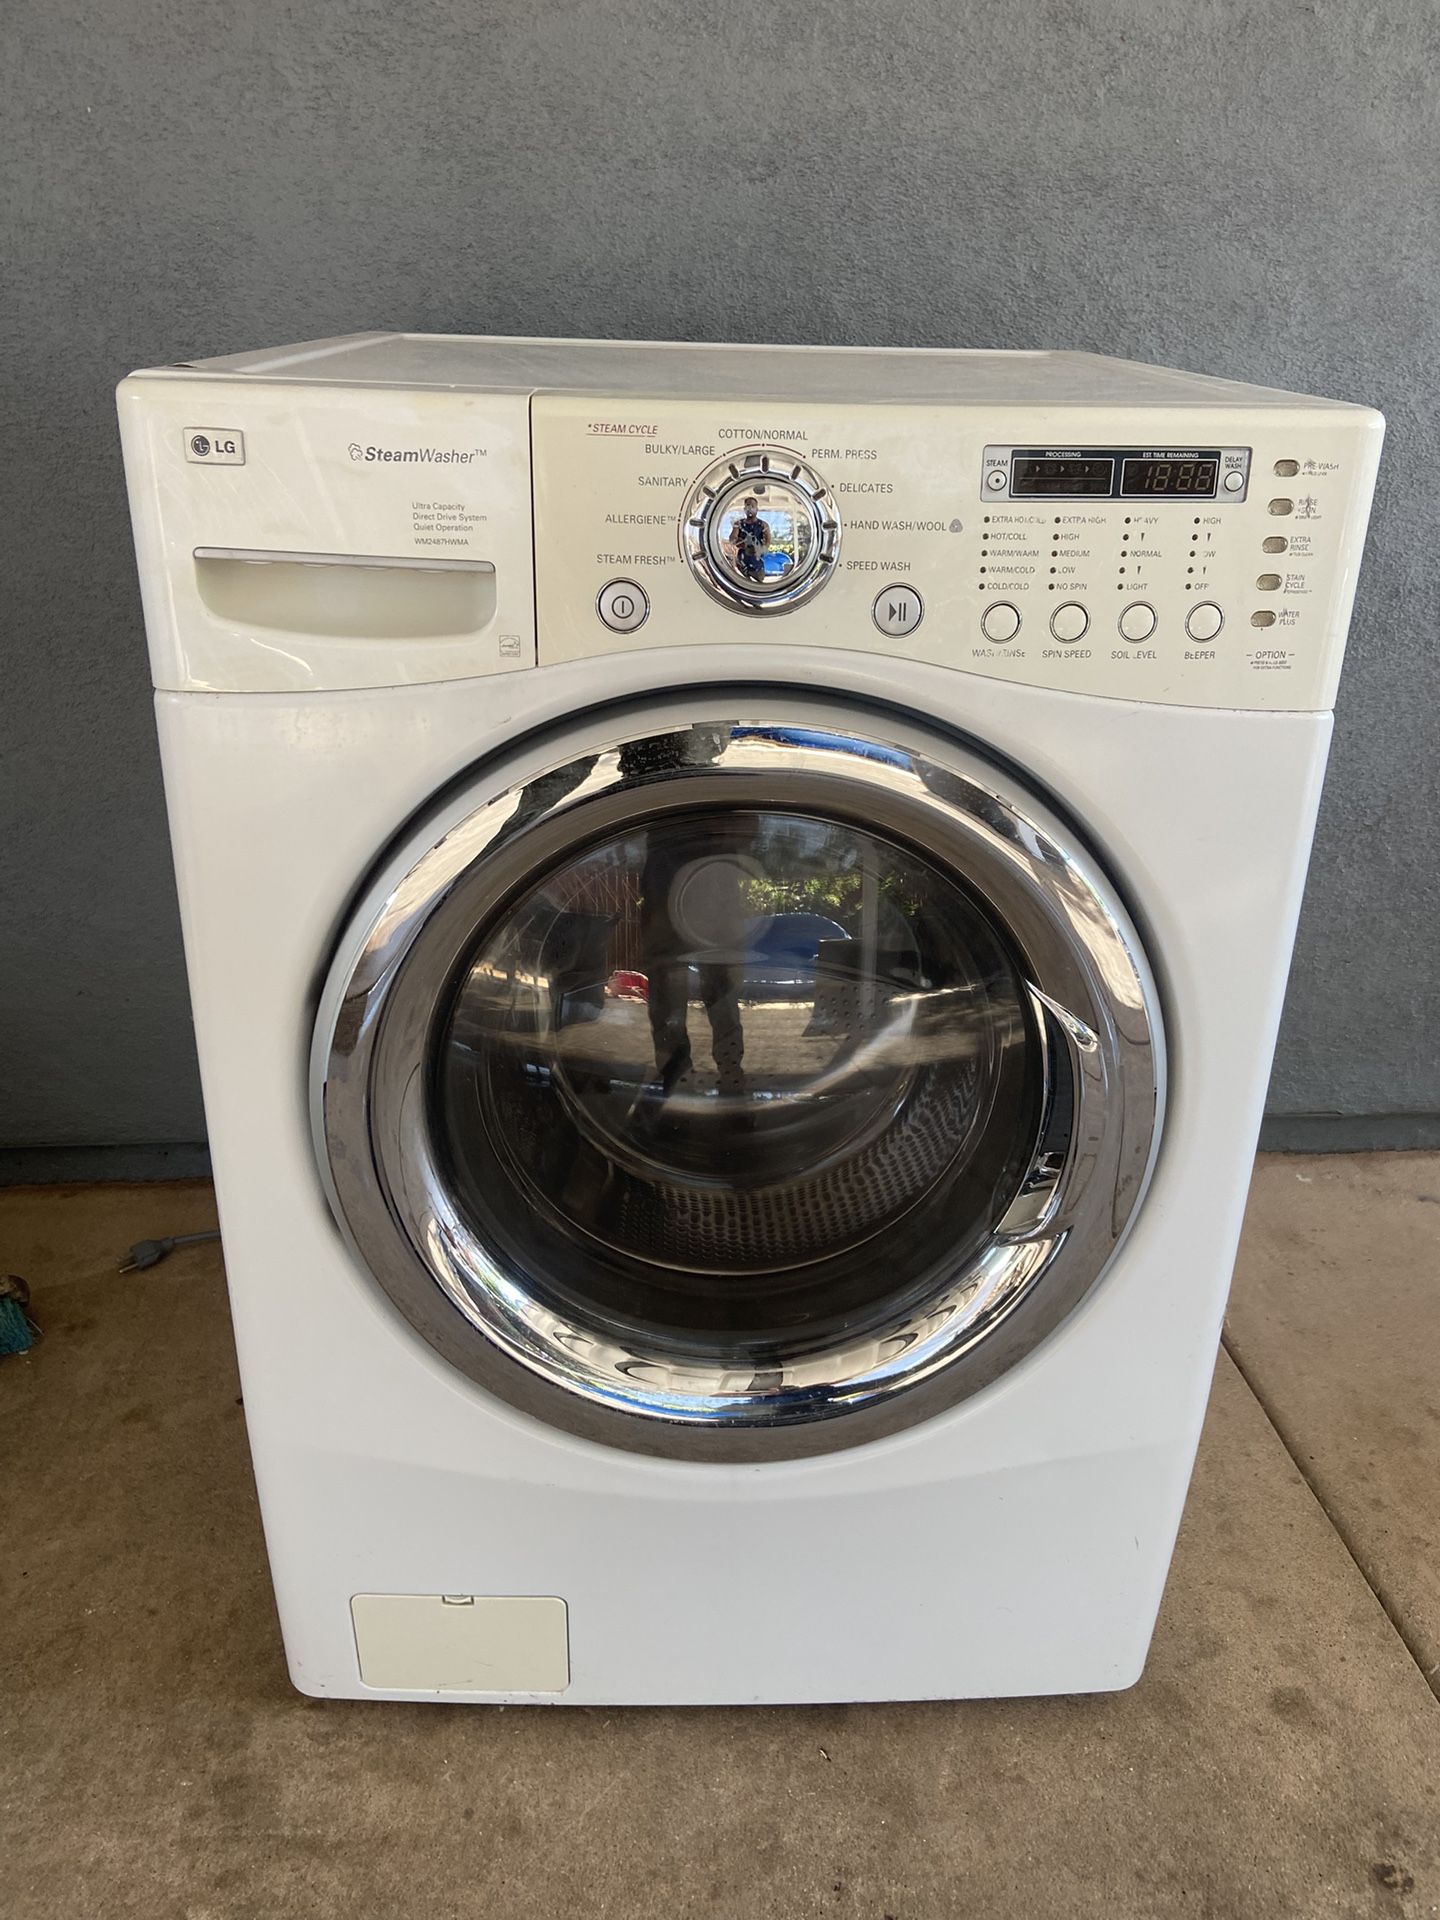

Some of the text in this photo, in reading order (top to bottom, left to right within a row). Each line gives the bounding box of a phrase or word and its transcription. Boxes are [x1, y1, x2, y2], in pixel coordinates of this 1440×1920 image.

[628, 424, 658, 435] CYCLE
[718, 429, 808, 441] COTTON/NORMAL
[215, 440, 235, 453] LG
[645, 443, 715, 455] BULKY/LARGE
[811, 449, 877, 460] PERM. PRESS
[986, 459, 1008, 467] STEAM
[638, 476, 689, 487] SANITARY
[840, 483, 893, 493] DELICATES
[412, 502, 465, 511] Ultra Capacity
[412, 512, 487, 522] Direct Drive System
[992, 515, 1013, 523] EXTRA
[1134, 516, 1159, 524] HAVY
[1203, 516, 1222, 525] HIGH
[413, 522, 473, 532] Quiet Operation
[850, 520, 947, 532] HAND WASH/WOOL
[1061, 533, 1080, 541] HIGH
[990, 549, 1039, 557] WARM/WARM
[1130, 550, 1162, 558] NORMAL
[597, 554, 631, 565] STEAM
[846, 561, 911, 572] SPEED WASH
[988, 566, 1035, 574] WARM/COLD
[1285, 573, 1305, 581] STAIN
[987, 582, 1030, 591] COLD/COLD
[1056, 582, 1088, 591] NO SPIN
[1126, 583, 1148, 591] LIGHT
[1194, 583, 1209, 591] OFF
[1284, 581, 1304, 589] CYCLE
[1042, 649, 1092, 659] SPIN SPEED
[1111, 650, 1157, 660] SOIL EVEL
[1184, 650, 1216, 660] BEEPER
[1255, 650, 1287, 659] OPTION
